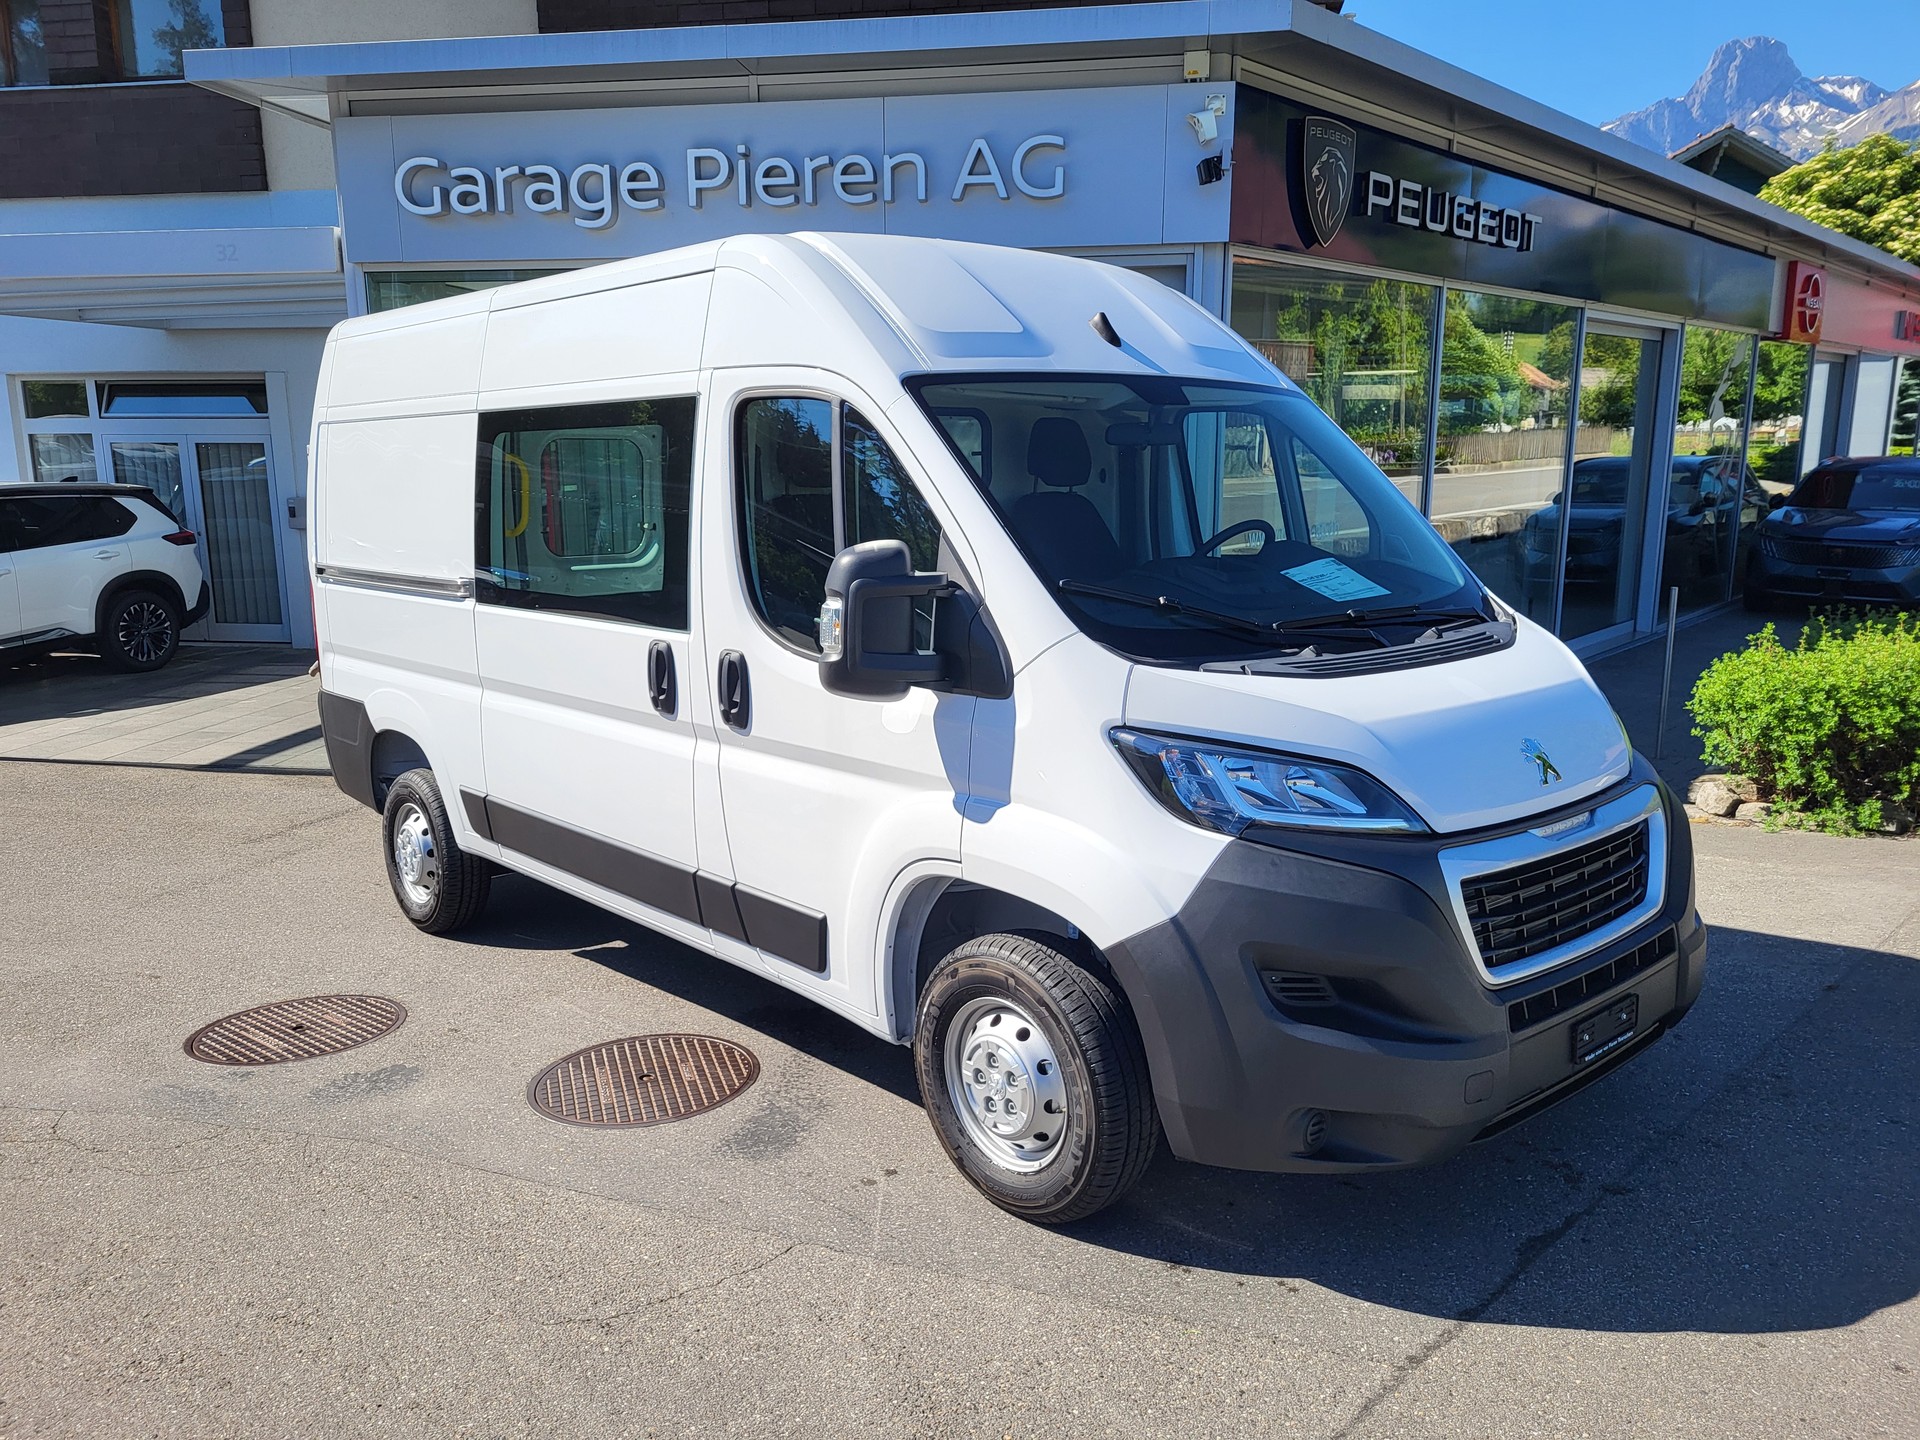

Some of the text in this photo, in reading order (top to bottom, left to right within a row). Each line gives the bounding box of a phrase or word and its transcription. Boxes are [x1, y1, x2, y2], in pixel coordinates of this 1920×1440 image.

[1310, 126, 1353, 147] PEUGEOT
[393, 133, 1066, 229] Garage Pieren AG
[1366, 170, 1543, 252] PEUGEOT
[216, 244, 239, 261] 32
[1060, 1047, 1085, 1150] NEXEN
